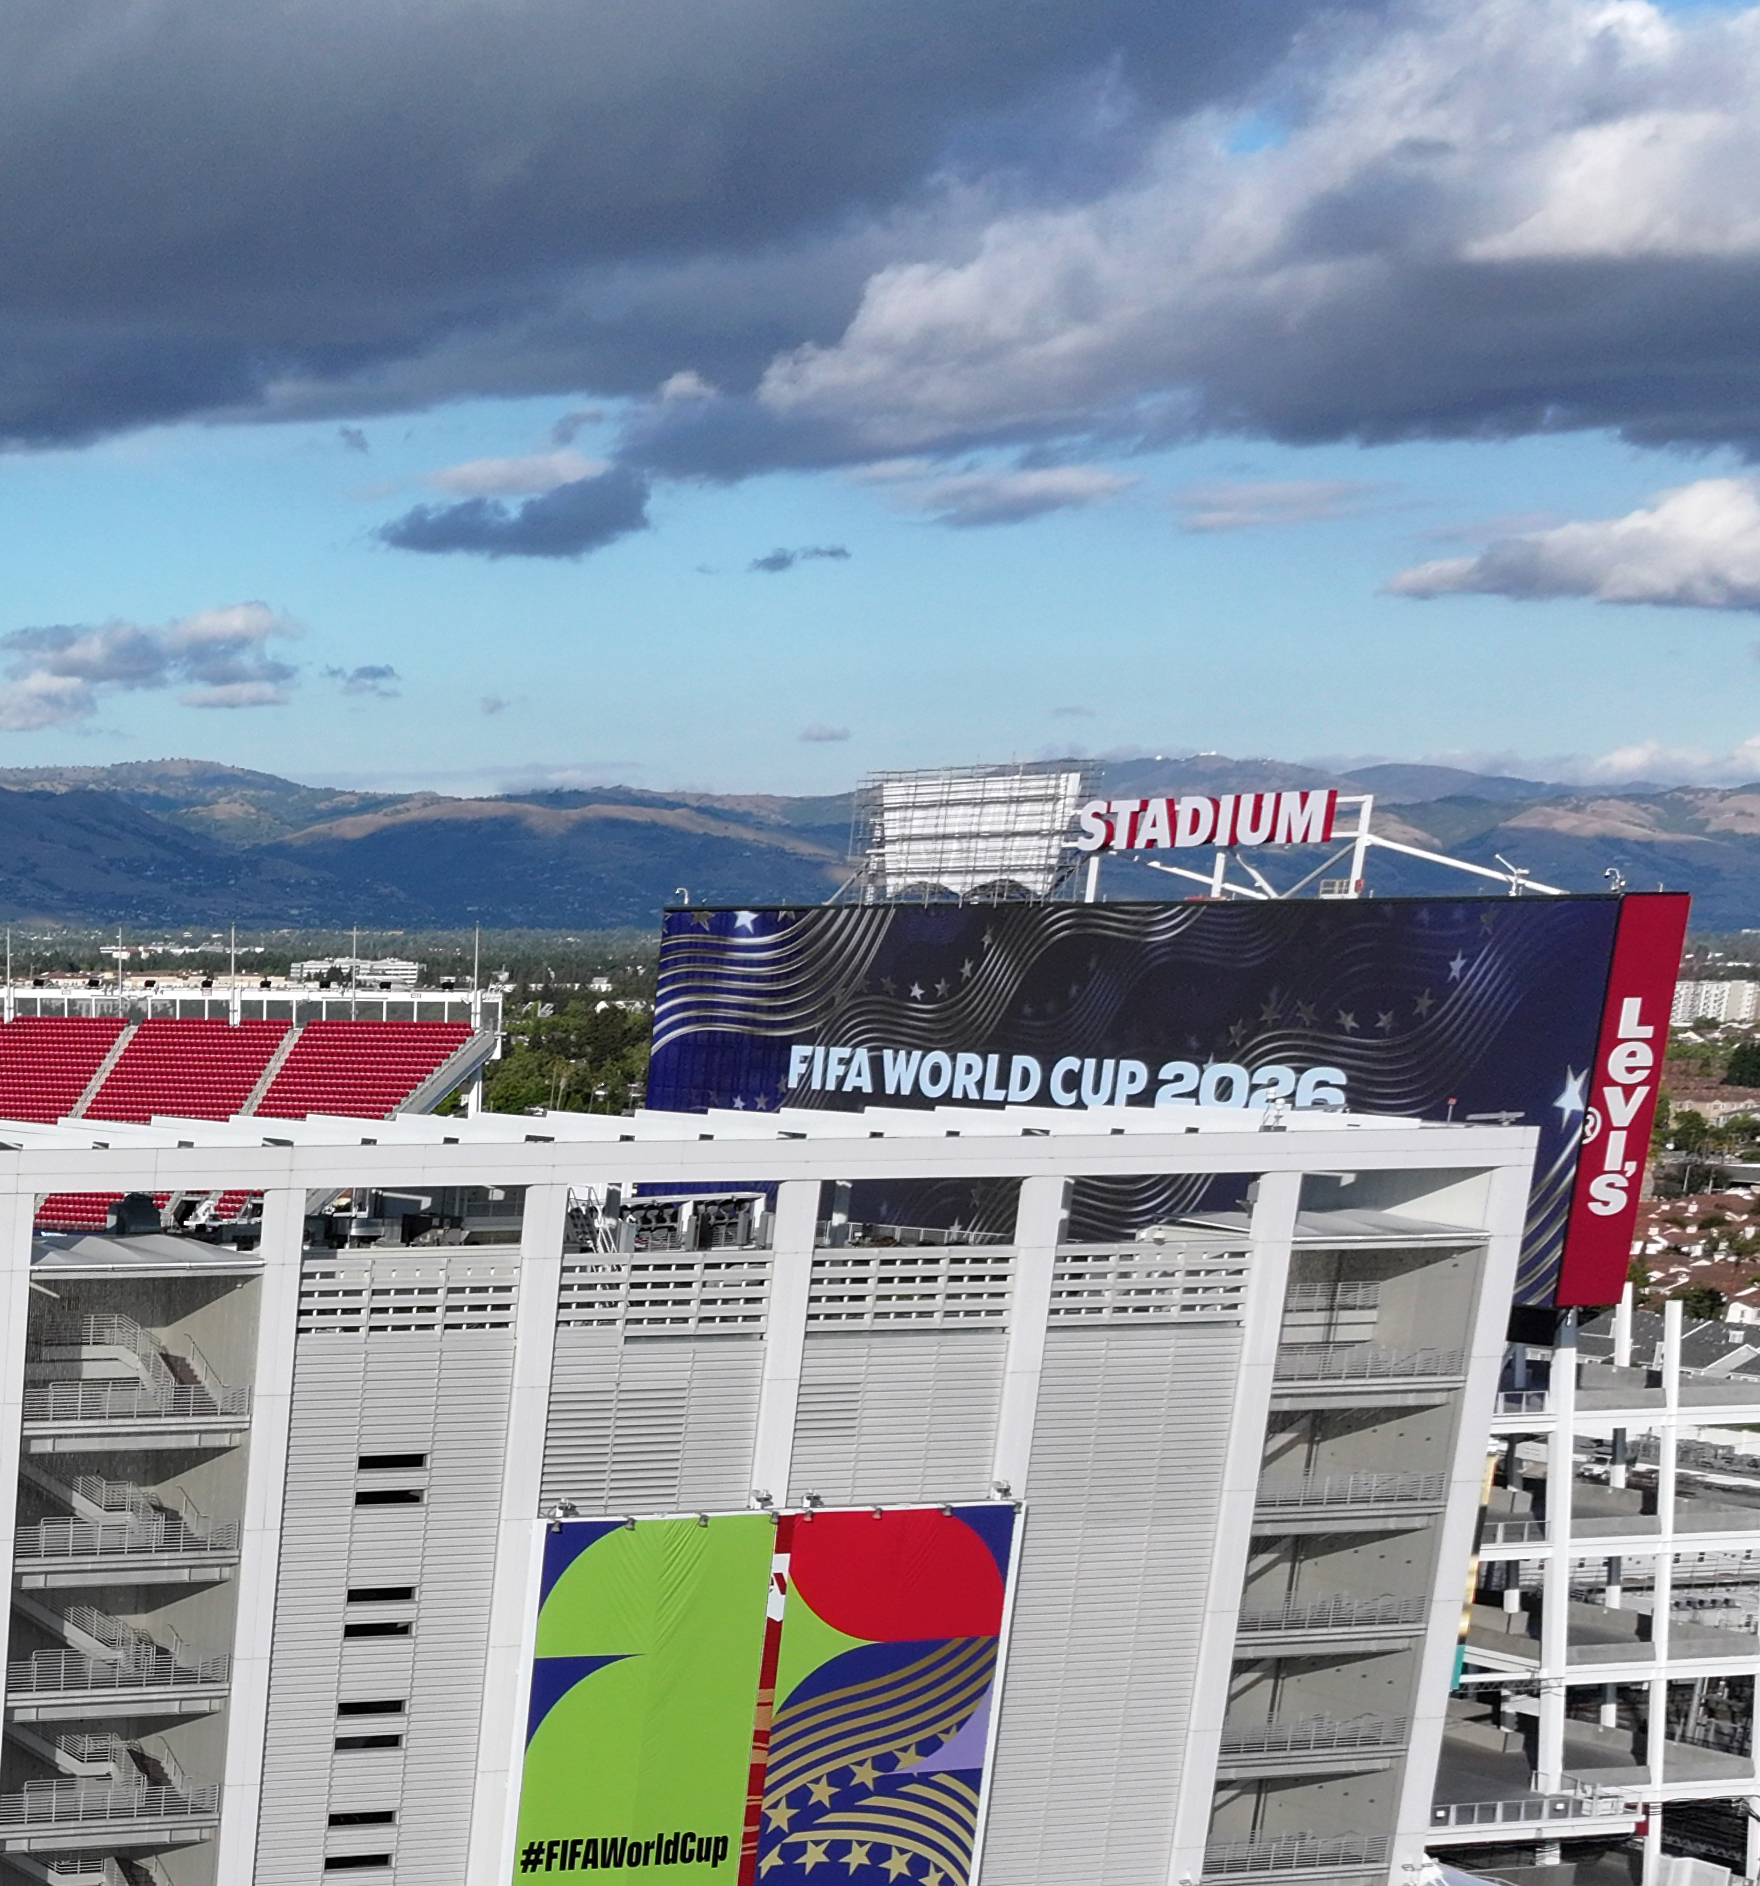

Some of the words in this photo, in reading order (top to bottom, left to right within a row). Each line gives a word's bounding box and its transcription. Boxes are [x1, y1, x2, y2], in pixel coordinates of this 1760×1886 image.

[1077, 789, 1338, 851] STADIUM
[788, 1044, 872, 1092] FIFA
[882, 1048, 1041, 1104] WORLD
[1051, 1056, 1147, 1108] CUP
[1157, 1061, 1347, 1108] 2026
[1586, 996, 1656, 1217] Levi's
[519, 1830, 729, 1874] #FIFAWorldCup
